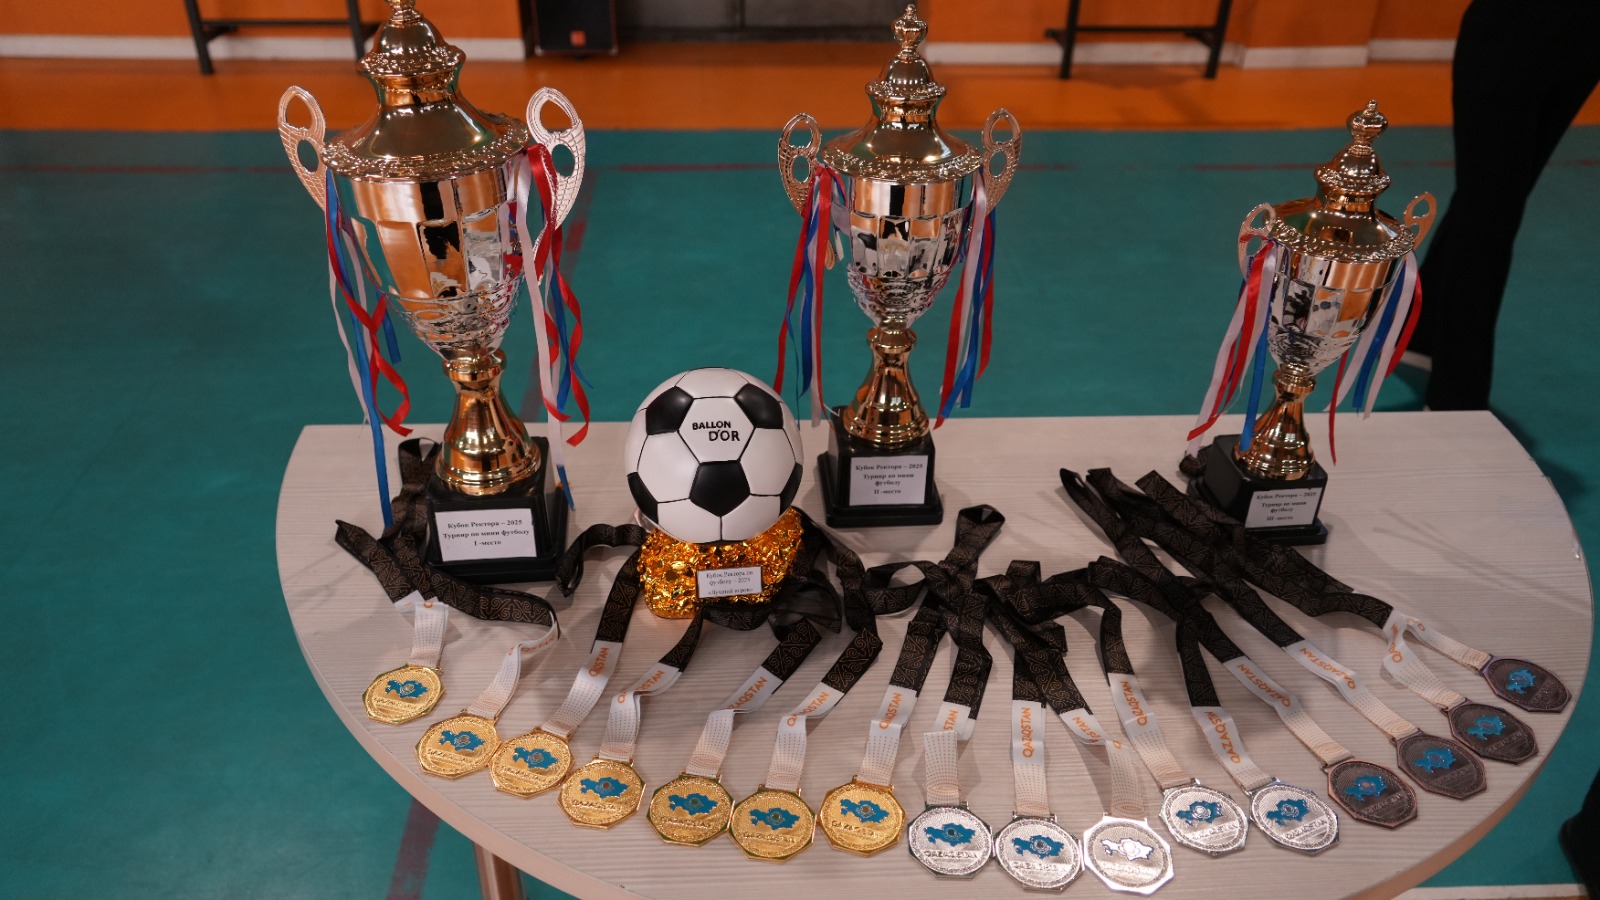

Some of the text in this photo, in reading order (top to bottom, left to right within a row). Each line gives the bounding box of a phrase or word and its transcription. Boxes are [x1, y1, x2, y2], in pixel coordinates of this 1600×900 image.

[692, 421, 731, 430] BALLON
[708, 429, 740, 441] D'OR
[1236, 663, 1292, 708] QAZAQSTAN
[1021, 707, 1035, 758] QAZAQSTAN
